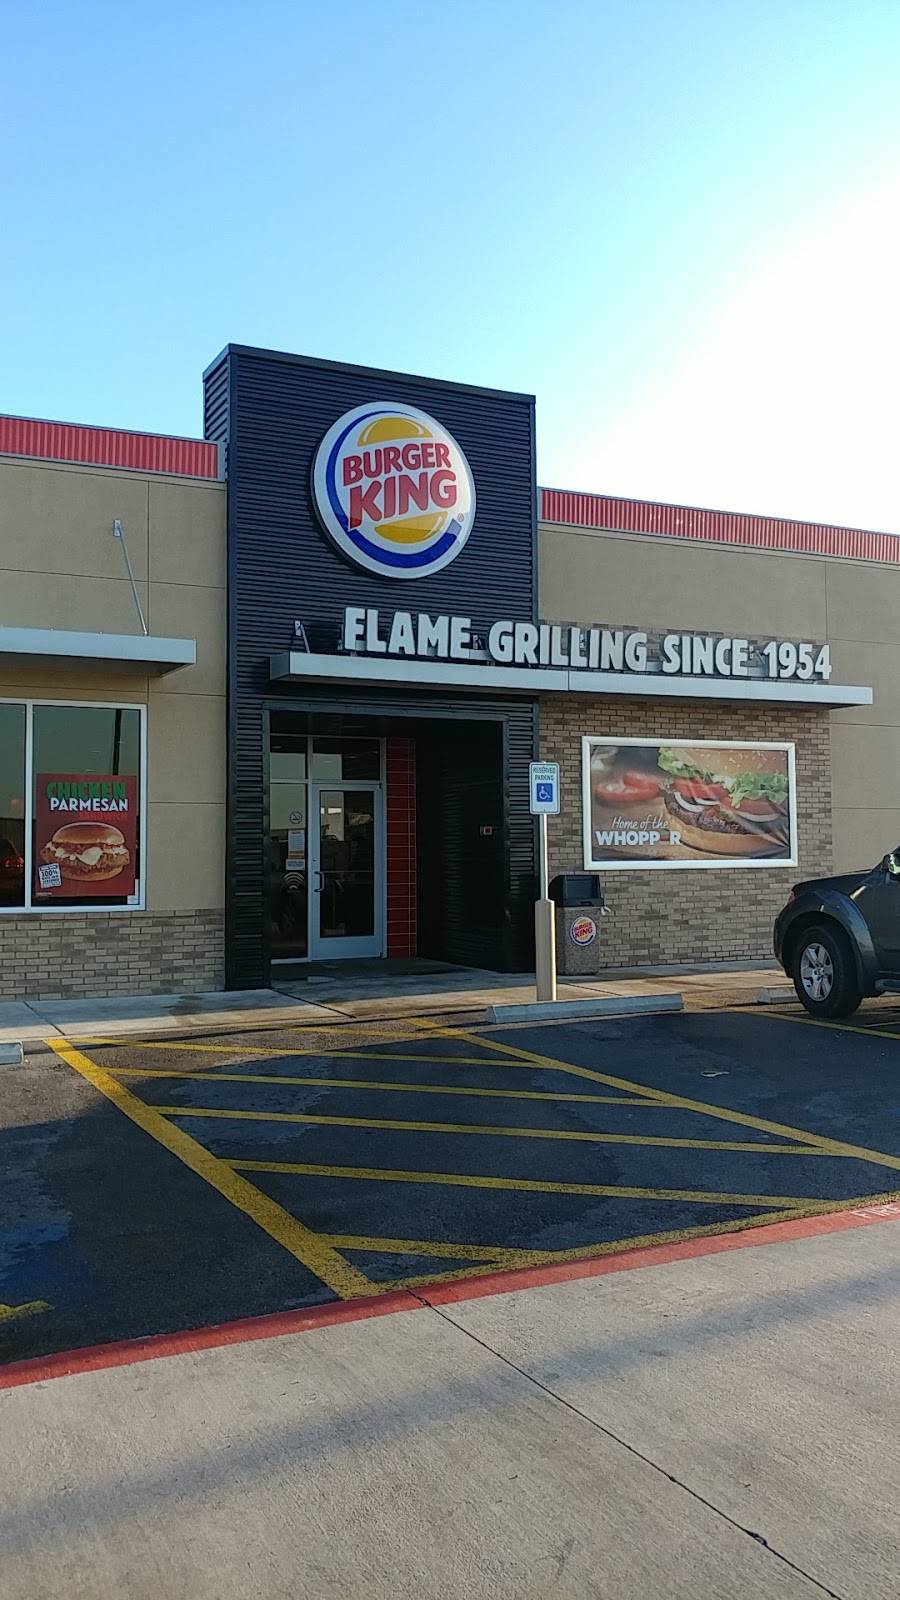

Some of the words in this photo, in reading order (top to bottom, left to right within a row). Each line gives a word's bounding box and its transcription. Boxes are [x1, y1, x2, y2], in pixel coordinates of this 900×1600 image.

[342, 442, 452, 486] BURGER
[348, 470, 457, 529] KING
[344, 606, 471, 659] FLAME
[487, 620, 648, 671] GRILLING
[663, 634, 748, 677] SINCE
[764, 642, 832, 680] 1954
[47, 782, 126, 799] CHICKEN
[50, 798, 129, 812] PARMESAN
[611, 816, 638, 829] Home
[640, 816, 651, 829] of
[652, 815, 669, 829] the
[595, 829, 682, 846] WHOPPR
[574, 927, 593, 938] KING
